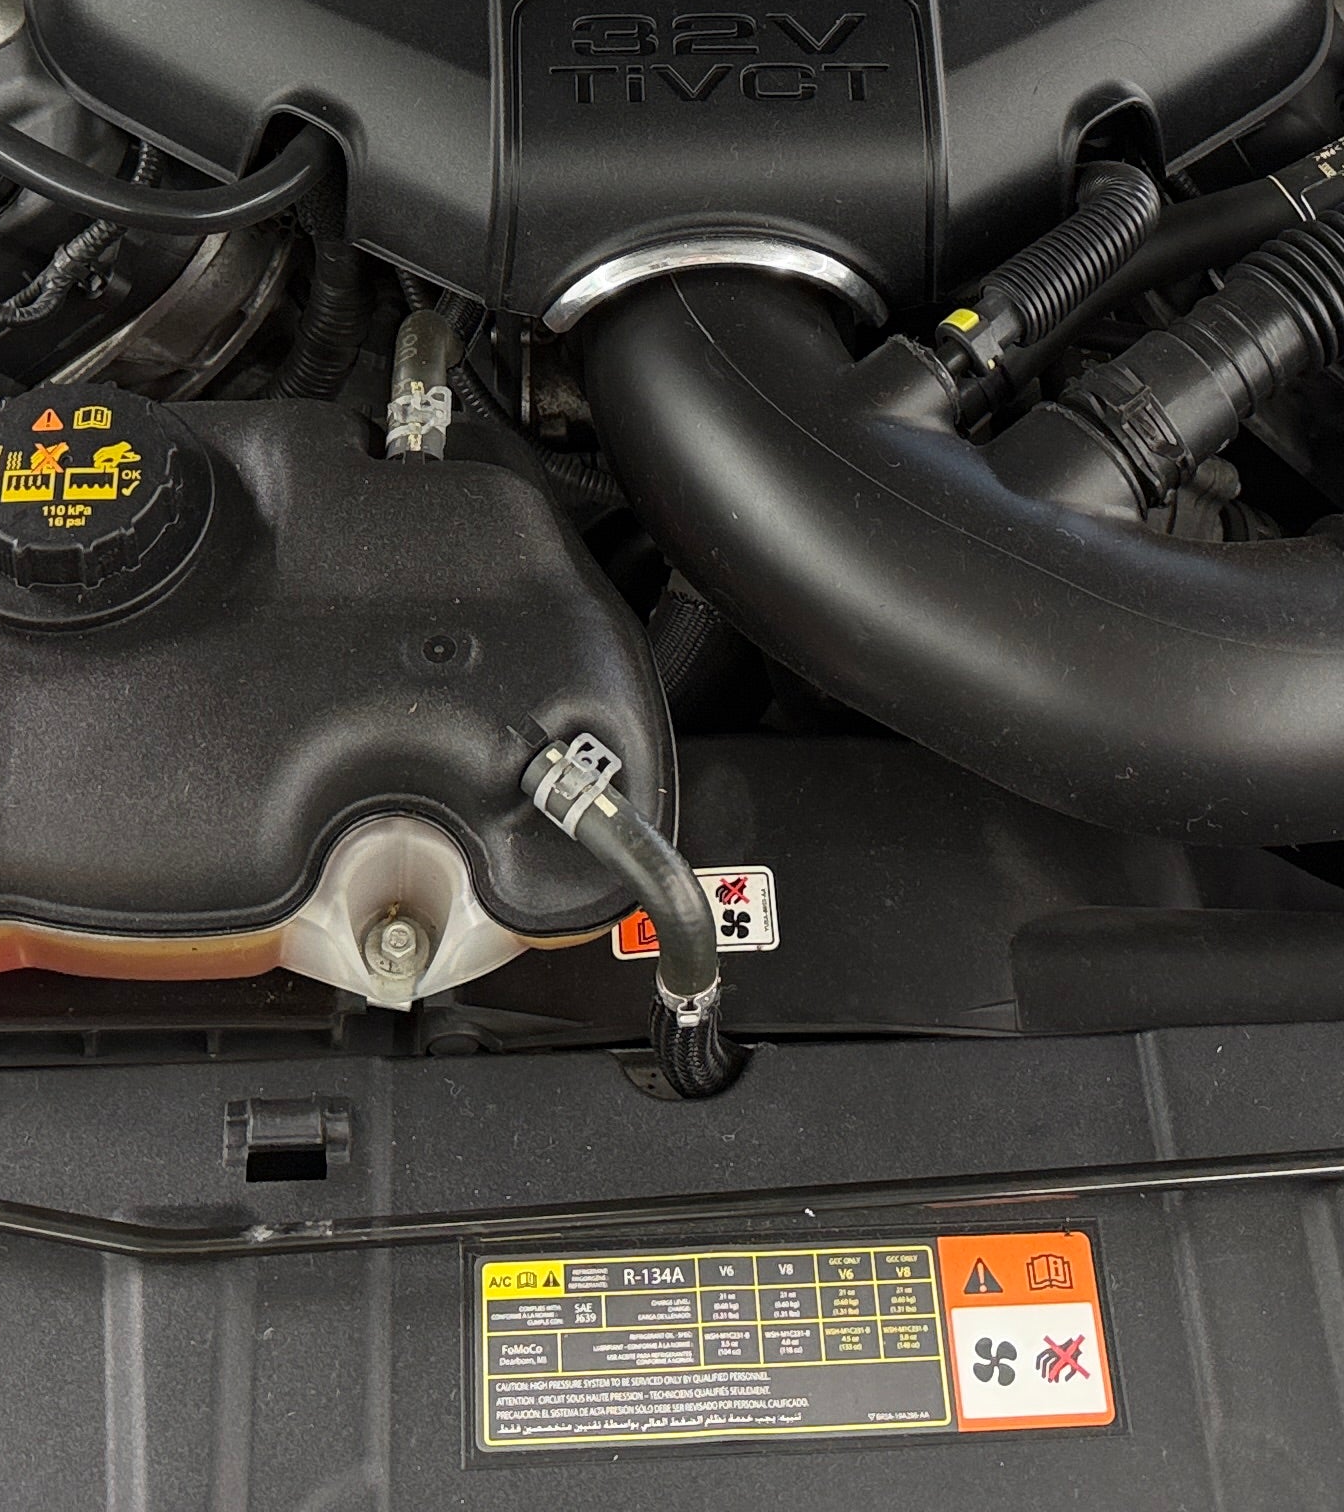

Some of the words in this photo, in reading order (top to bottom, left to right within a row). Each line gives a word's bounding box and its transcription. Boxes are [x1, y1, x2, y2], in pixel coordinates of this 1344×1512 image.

[571, 12, 868, 57] 32V
[548, 63, 891, 105] TiVCT
[121, 470, 141, 480] OK
[42, 505, 66, 516] 110
[67, 504, 92, 516] kPa
[65, 516, 86, 529] psi
[718, 1265, 734, 1277] V6
[778, 1263, 794, 1275] V8
[838, 1268, 855, 1280] V6
[896, 1266, 912, 1278] V8
[623, 1266, 685, 1286] R-134A
[489, 1276, 512, 1289] A/C
[574, 1303, 593, 1314] SAE
[574, 1313, 598, 1324] J639
[501, 1344, 544, 1356] FoMoCo
